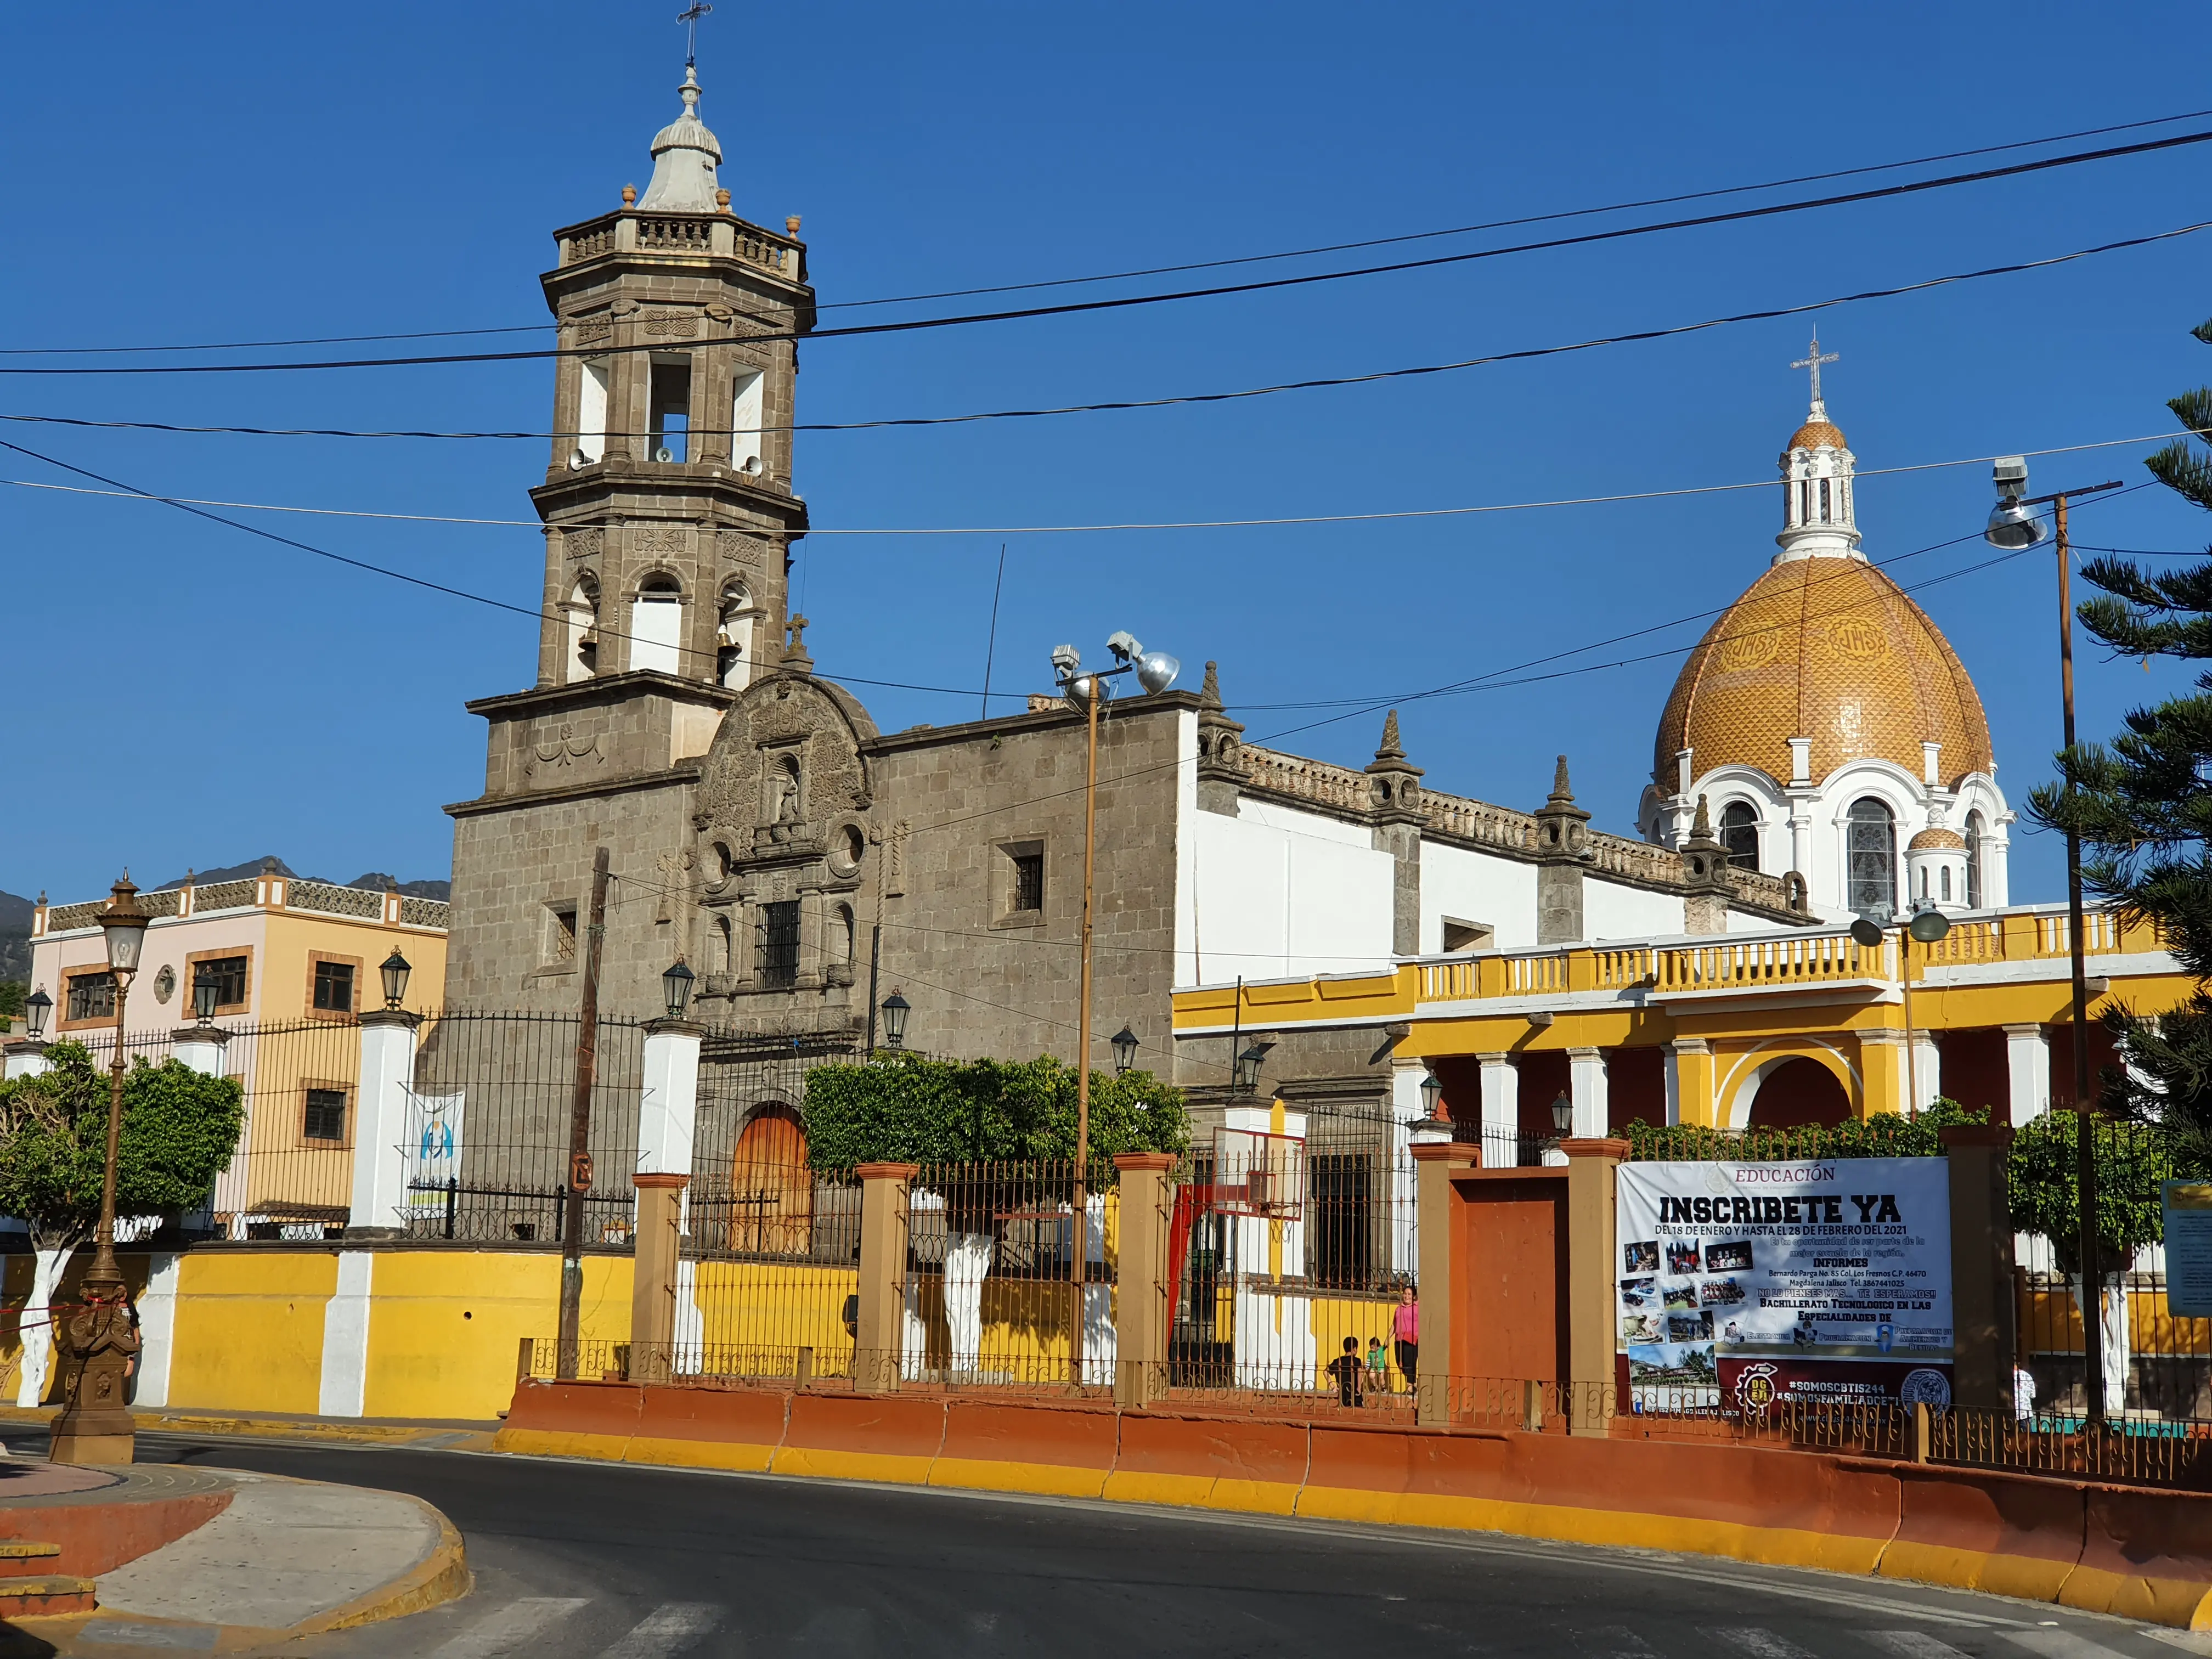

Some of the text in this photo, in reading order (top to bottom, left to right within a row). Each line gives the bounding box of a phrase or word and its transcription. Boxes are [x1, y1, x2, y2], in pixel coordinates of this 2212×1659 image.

[1735, 1164, 1835, 1182] EDUCACIÓN
[1660, 1194, 1901, 1223] INSCRIBETE YA
[1655, 1225, 1906, 1235] DEL 18 DE ENERO Y HASTA EL 28 DE FEBRERO DEL 2021
[1770, 1237, 1779, 1246] Es
[1792, 1237, 1847, 1247] oportunidad
[1849, 1236, 1860, 1245] de
[1876, 1237, 1901, 1246] parte
[1902, 1235, 1914, 1245] de
[1916, 1235, 1925, 1245] la
[1789, 1248, 1815, 1258] mejor
[1816, 1248, 1848, 1257] escuela
[1849, 1248, 1861, 1257] de
[1863, 1248, 1871, 1257] la
[1813, 1258, 1869, 1268] INFORMES
[1799, 1269, 1818, 1278] Parga
[1790, 1279, 1825, 1288] Magdalena
[1758, 1288, 1770, 1297] NO
[1771, 1288, 1783, 1297] LO
[1784, 1289, 1823, 1298] PIENSES
[1857, 1289, 1870, 1298] TE
[1874, 1289, 1937, 1299] ESPERAMOS!!
[1759, 1298, 1828, 1308] BACHILLERATO
[1897, 1301, 1909, 1310] EN
[1911, 1301, 1931, 1310] LAS
[1798, 1311, 1892, 1322] ESPECIALIDADES DE
[1751, 1379, 1767, 1389] DG
[1788, 1381, 1885, 1394] #SOMOSCBTIS244
